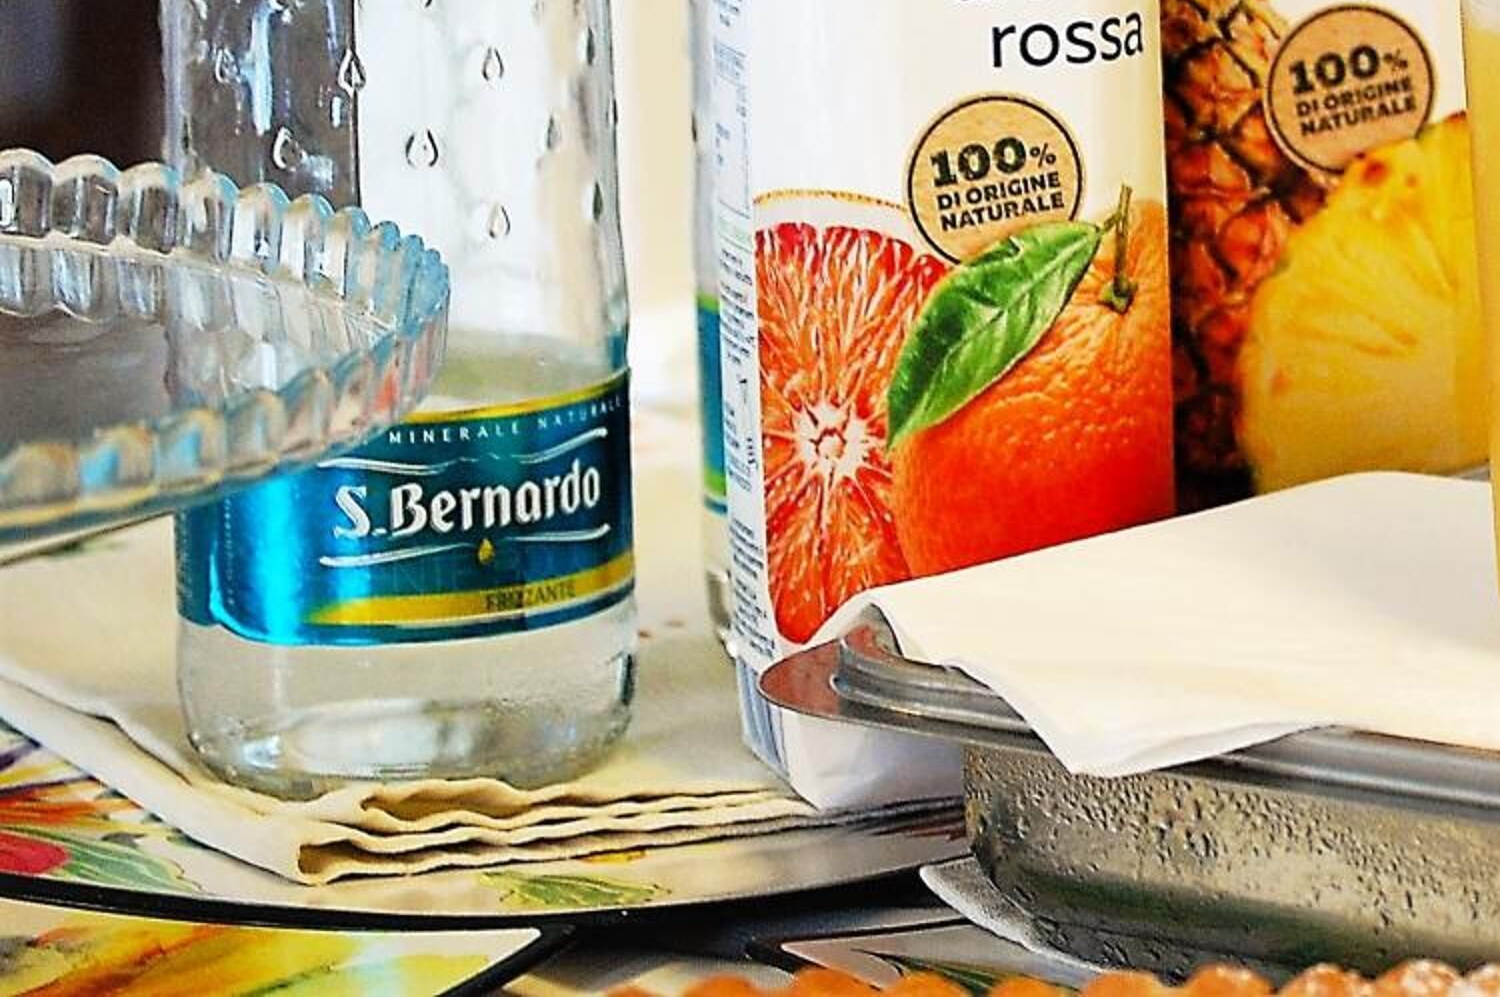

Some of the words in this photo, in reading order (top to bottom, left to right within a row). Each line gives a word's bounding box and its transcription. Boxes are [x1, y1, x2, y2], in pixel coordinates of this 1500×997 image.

[991, 11, 1144, 68] rossa
[1289, 44, 1409, 95] 100%
[1296, 99, 1319, 117] DI
[1323, 76, 1413, 111] ORIGINE
[1300, 95, 1417, 137] NATURALE
[930, 136, 1057, 188] 100%
[937, 191, 960, 211] DI
[965, 170, 1062, 204] ORIGINE
[940, 191, 1065, 232] NATURALE
[388, 422, 520, 445] MINERALE
[485, 580, 577, 612] FRIZZANTE
